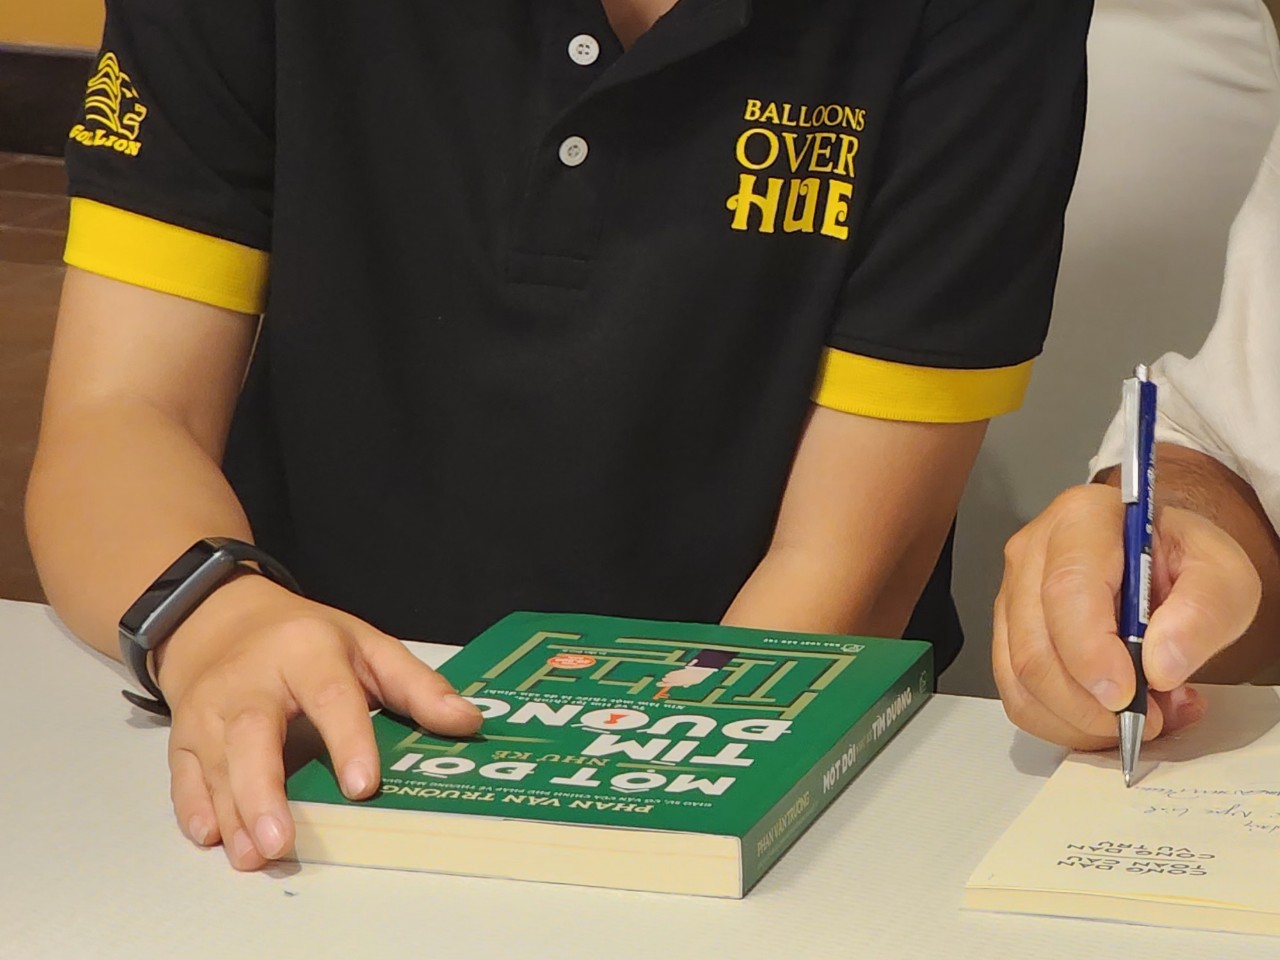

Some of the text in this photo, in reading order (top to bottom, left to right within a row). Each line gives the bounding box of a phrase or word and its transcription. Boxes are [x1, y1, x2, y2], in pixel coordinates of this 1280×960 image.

[744, 99, 867, 132] BALLOONS
[735, 127, 859, 178] OVER
[726, 173, 853, 241] HUE
[536, 753, 610, 767] NHƯ
[580, 733, 755, 767] TÌM
[390, 753, 736, 795] MỘT ĐỜI
[382, 784, 654, 814] PHAN VĂN TRƯỜNG
